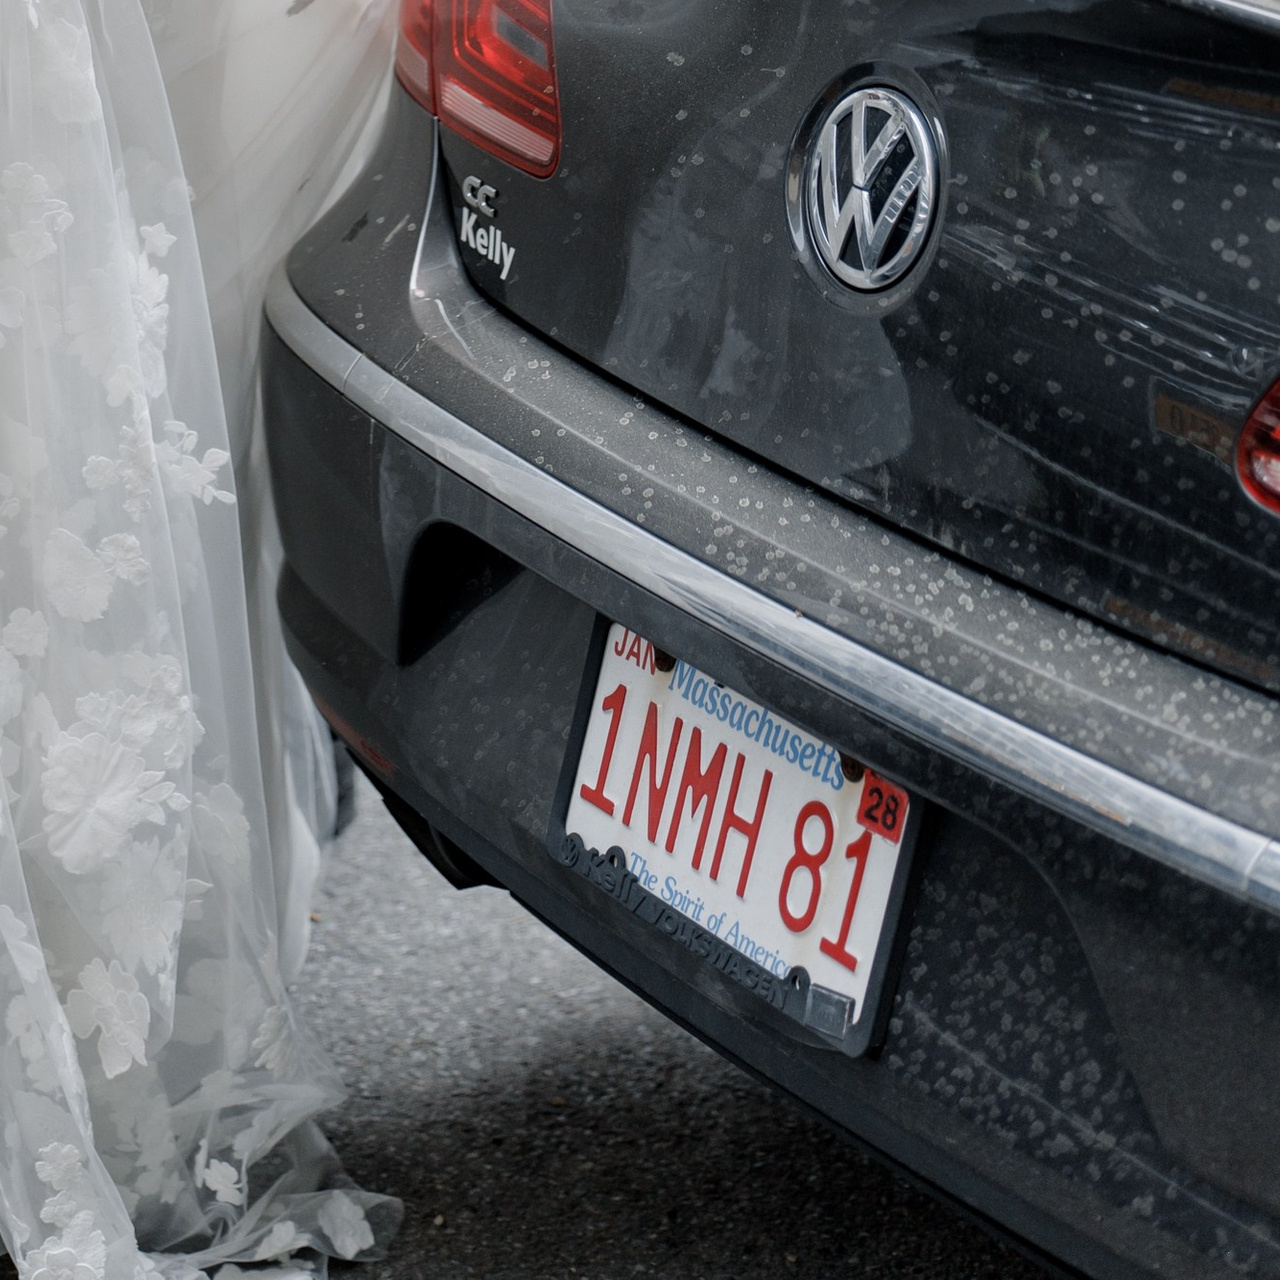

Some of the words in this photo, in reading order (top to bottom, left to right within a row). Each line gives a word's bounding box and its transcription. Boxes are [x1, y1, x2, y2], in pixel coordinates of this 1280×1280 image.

[461, 206, 516, 280] Kelly
[614, 628, 656, 675] JAN
[668, 659, 844, 791] Massachusetts
[580, 683, 774, 899] 1NMH
[778, 800, 874, 973] 81
[863, 786, 900, 831] 28
[630, 851, 658, 891] The
[660, 875, 705, 921] Spirit
[706, 912, 727, 934] of
